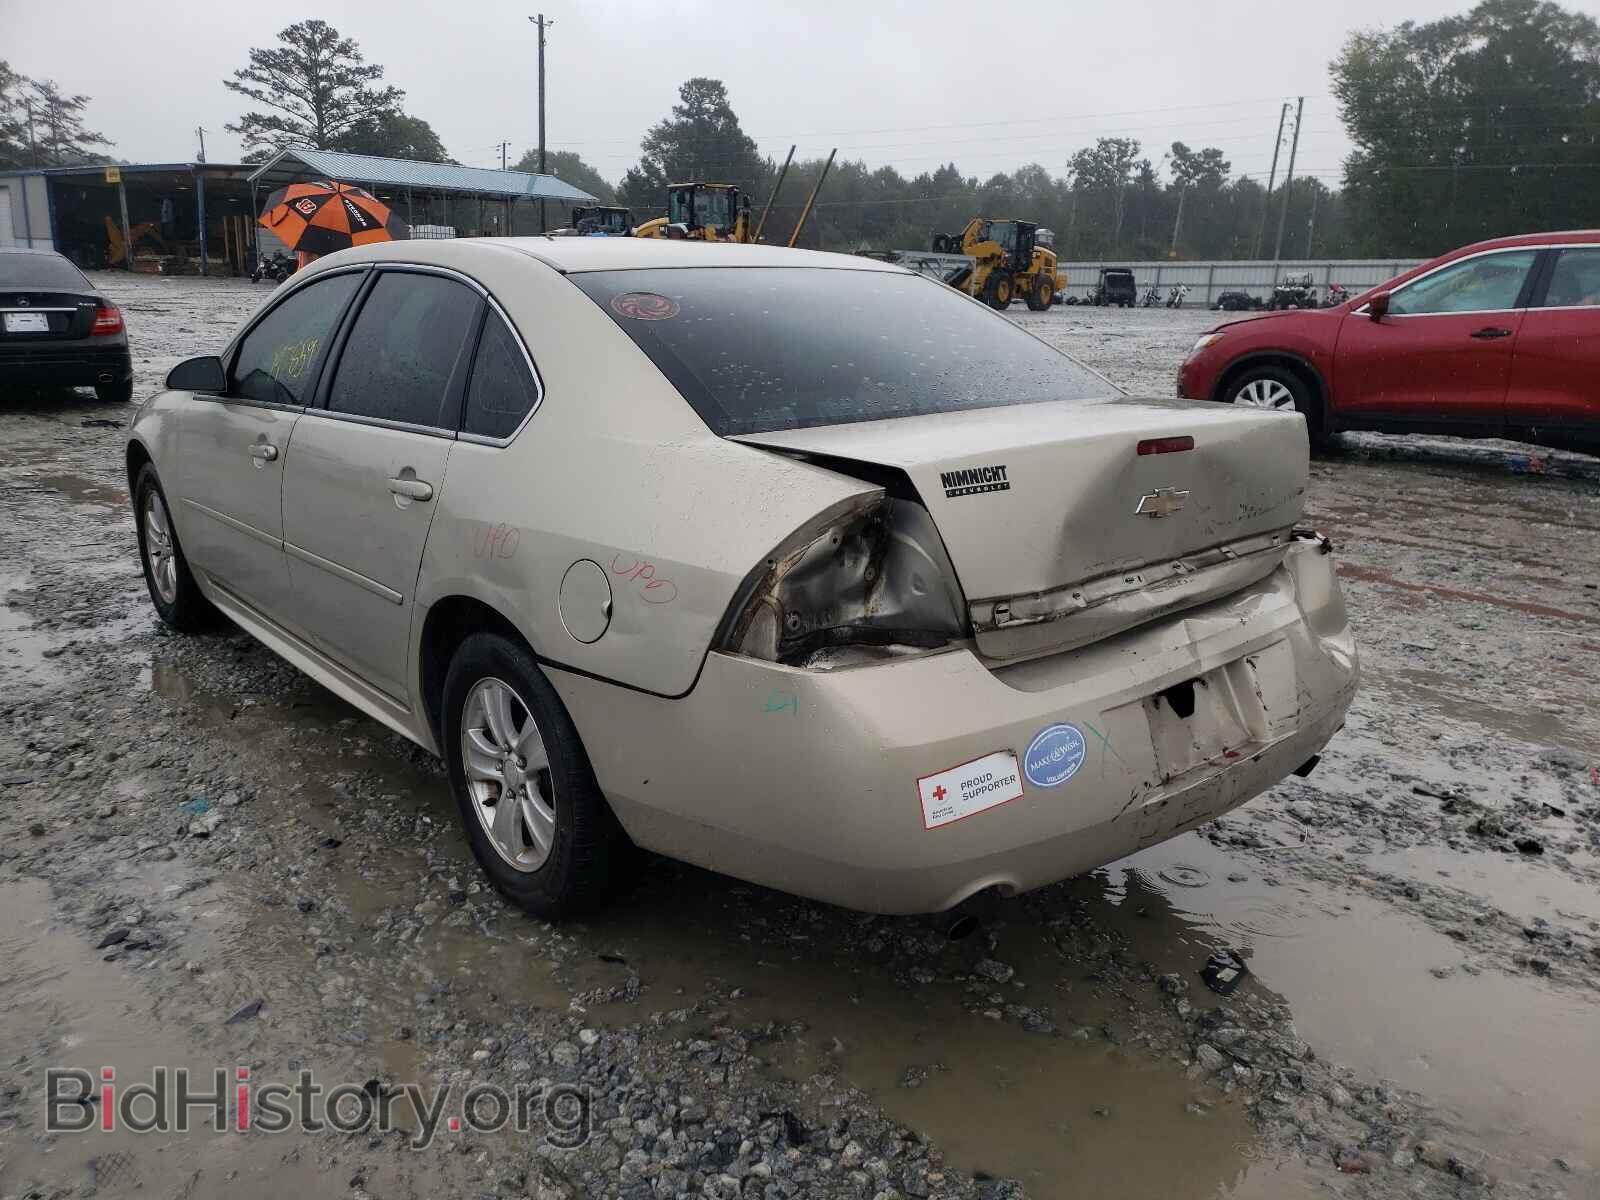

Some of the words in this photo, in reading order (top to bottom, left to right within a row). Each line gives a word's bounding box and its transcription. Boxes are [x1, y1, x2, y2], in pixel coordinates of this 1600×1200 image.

[940, 465, 1006, 488] NIMNICHT
[947, 483, 1009, 497] CHEVROLET
[960, 772, 993, 791] PROUD
[962, 774, 1016, 801] SUPPORTER
